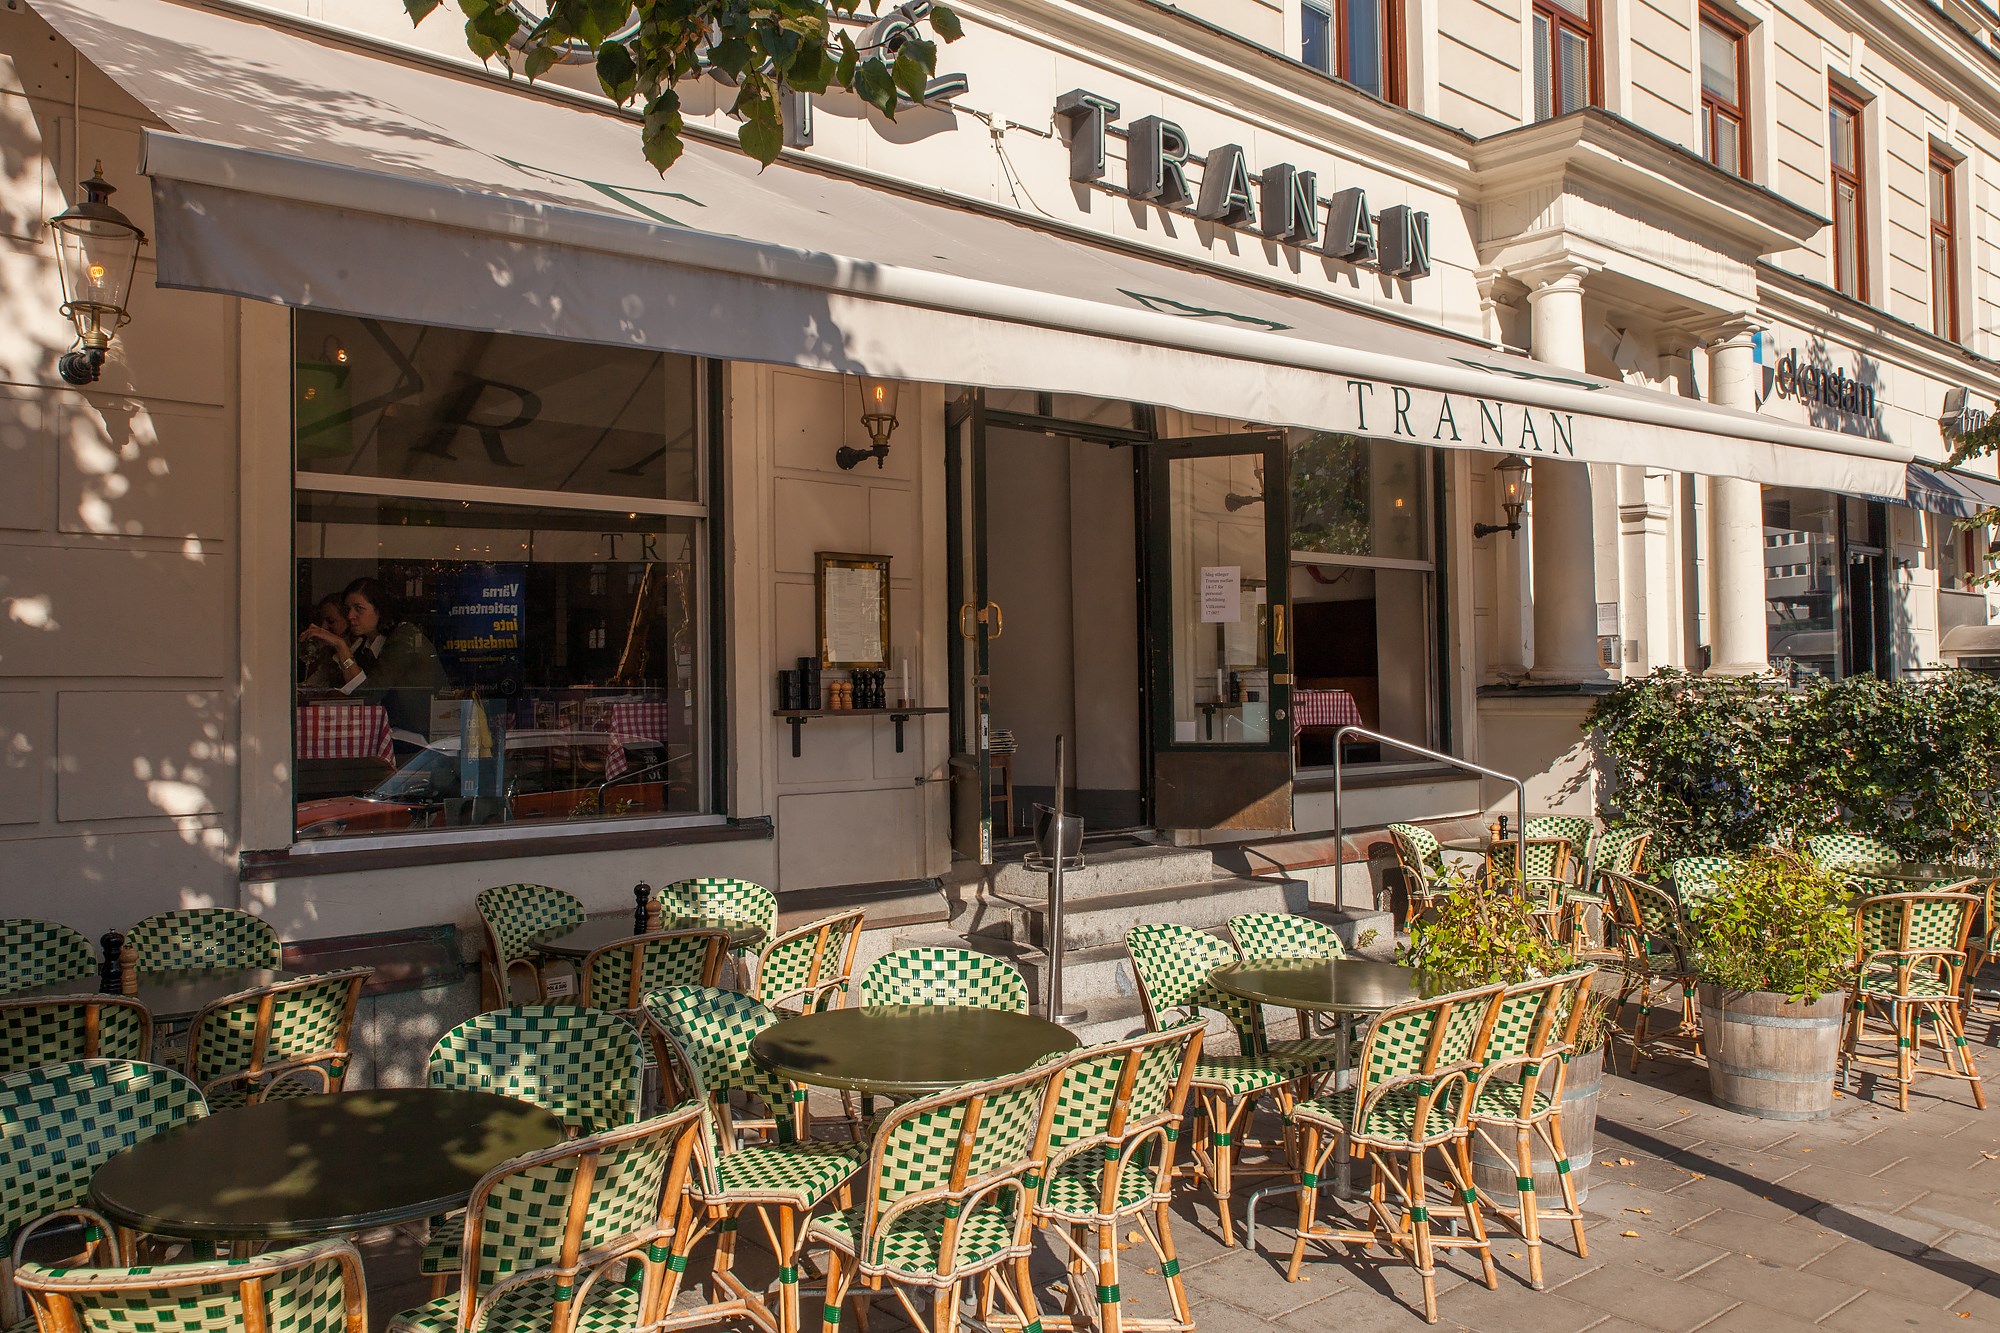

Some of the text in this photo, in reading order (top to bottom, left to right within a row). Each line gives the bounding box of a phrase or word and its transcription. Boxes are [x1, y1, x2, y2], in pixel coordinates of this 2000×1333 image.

[1057, 88, 1431, 281] TRANAN
[1346, 380, 1574, 457] TRANAN
[1776, 347, 1875, 418] ekenstam
